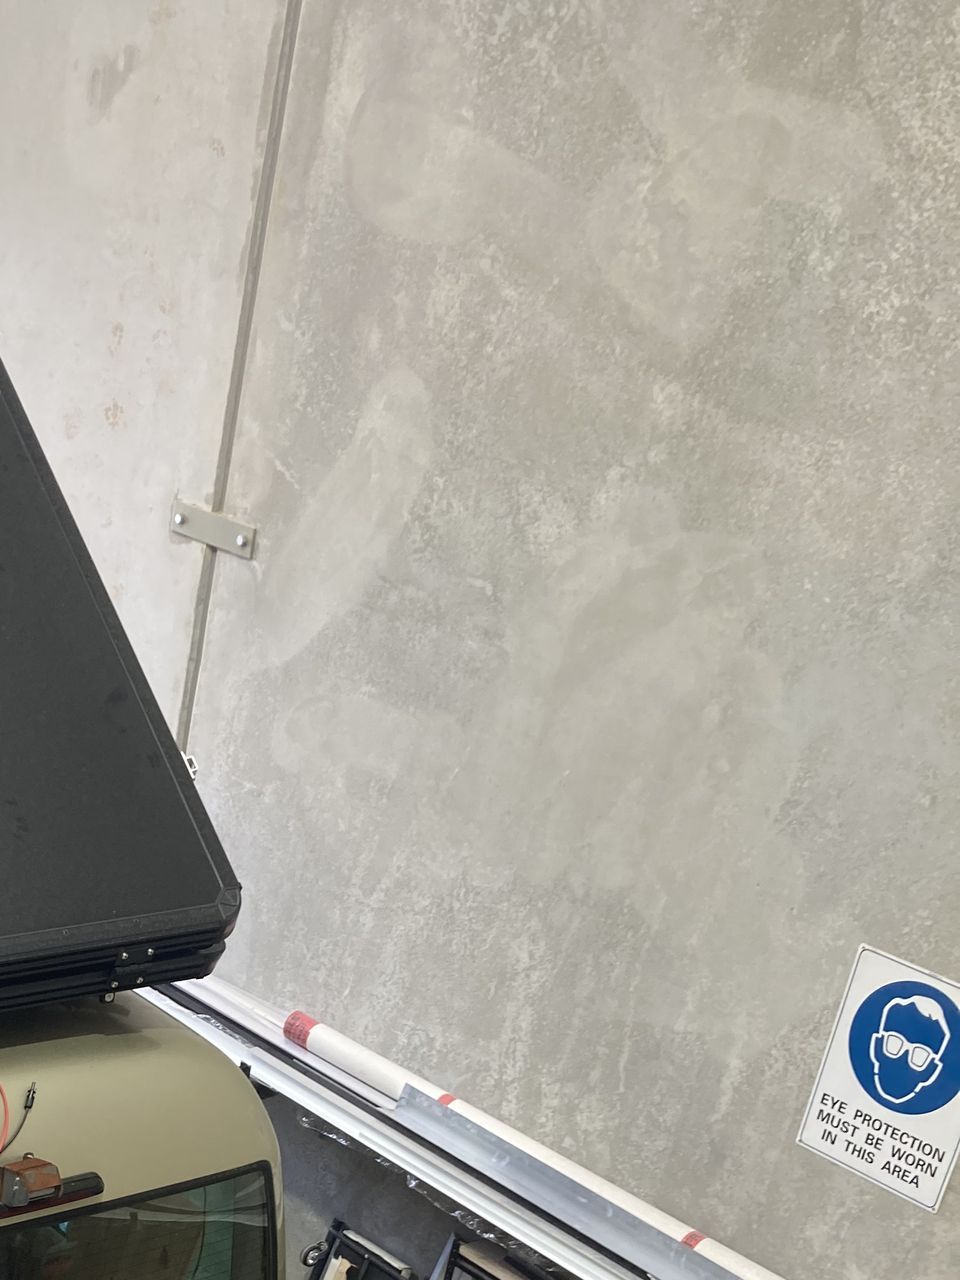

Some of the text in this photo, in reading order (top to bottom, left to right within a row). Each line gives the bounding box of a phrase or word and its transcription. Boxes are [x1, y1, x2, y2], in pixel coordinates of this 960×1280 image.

[816, 1109, 938, 1178] MUST BE WORN
[820, 1093, 946, 1163] EYE PROTECTION
[821, 1128, 920, 1189] IN THIS AREA
